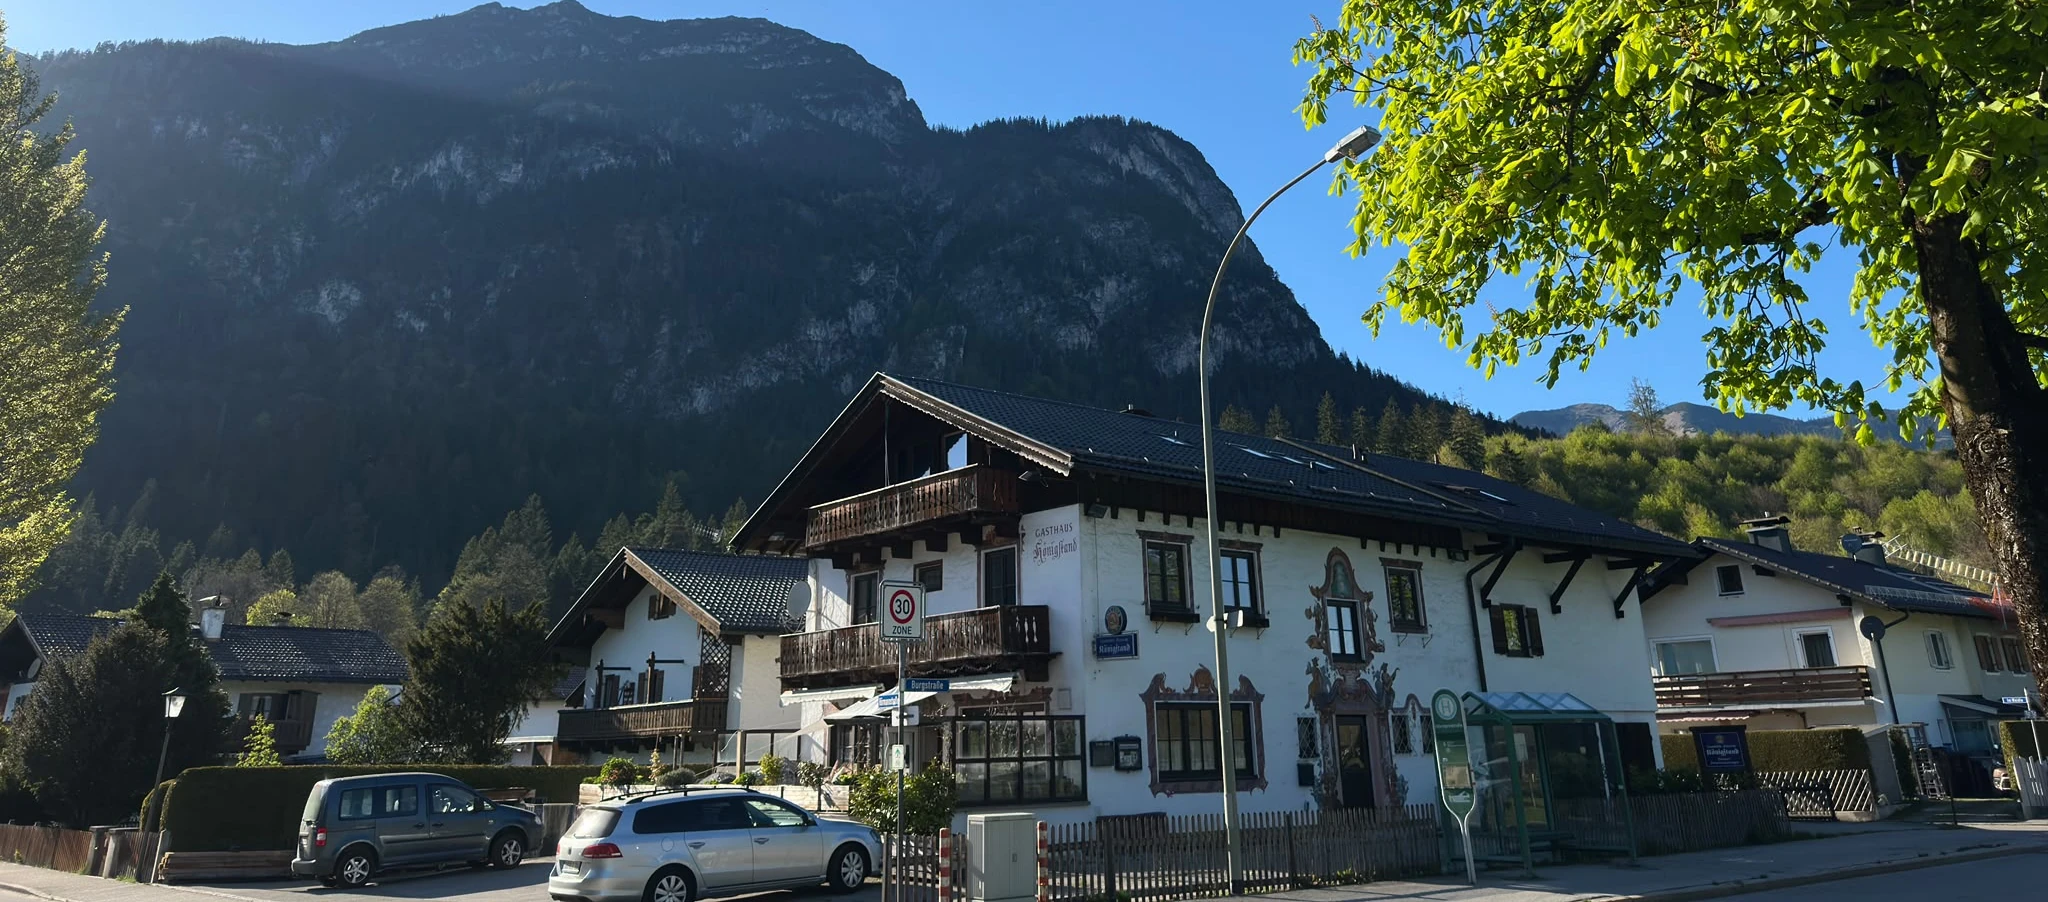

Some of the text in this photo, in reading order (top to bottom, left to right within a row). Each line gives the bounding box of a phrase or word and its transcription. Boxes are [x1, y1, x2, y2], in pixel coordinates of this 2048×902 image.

[1035, 522, 1073, 538] GASTHAUS
[895, 598, 910, 615] 30
[892, 625, 912, 636] ZONE
[911, 680, 944, 690] Burgstraße
[1441, 700, 1451, 714] H
